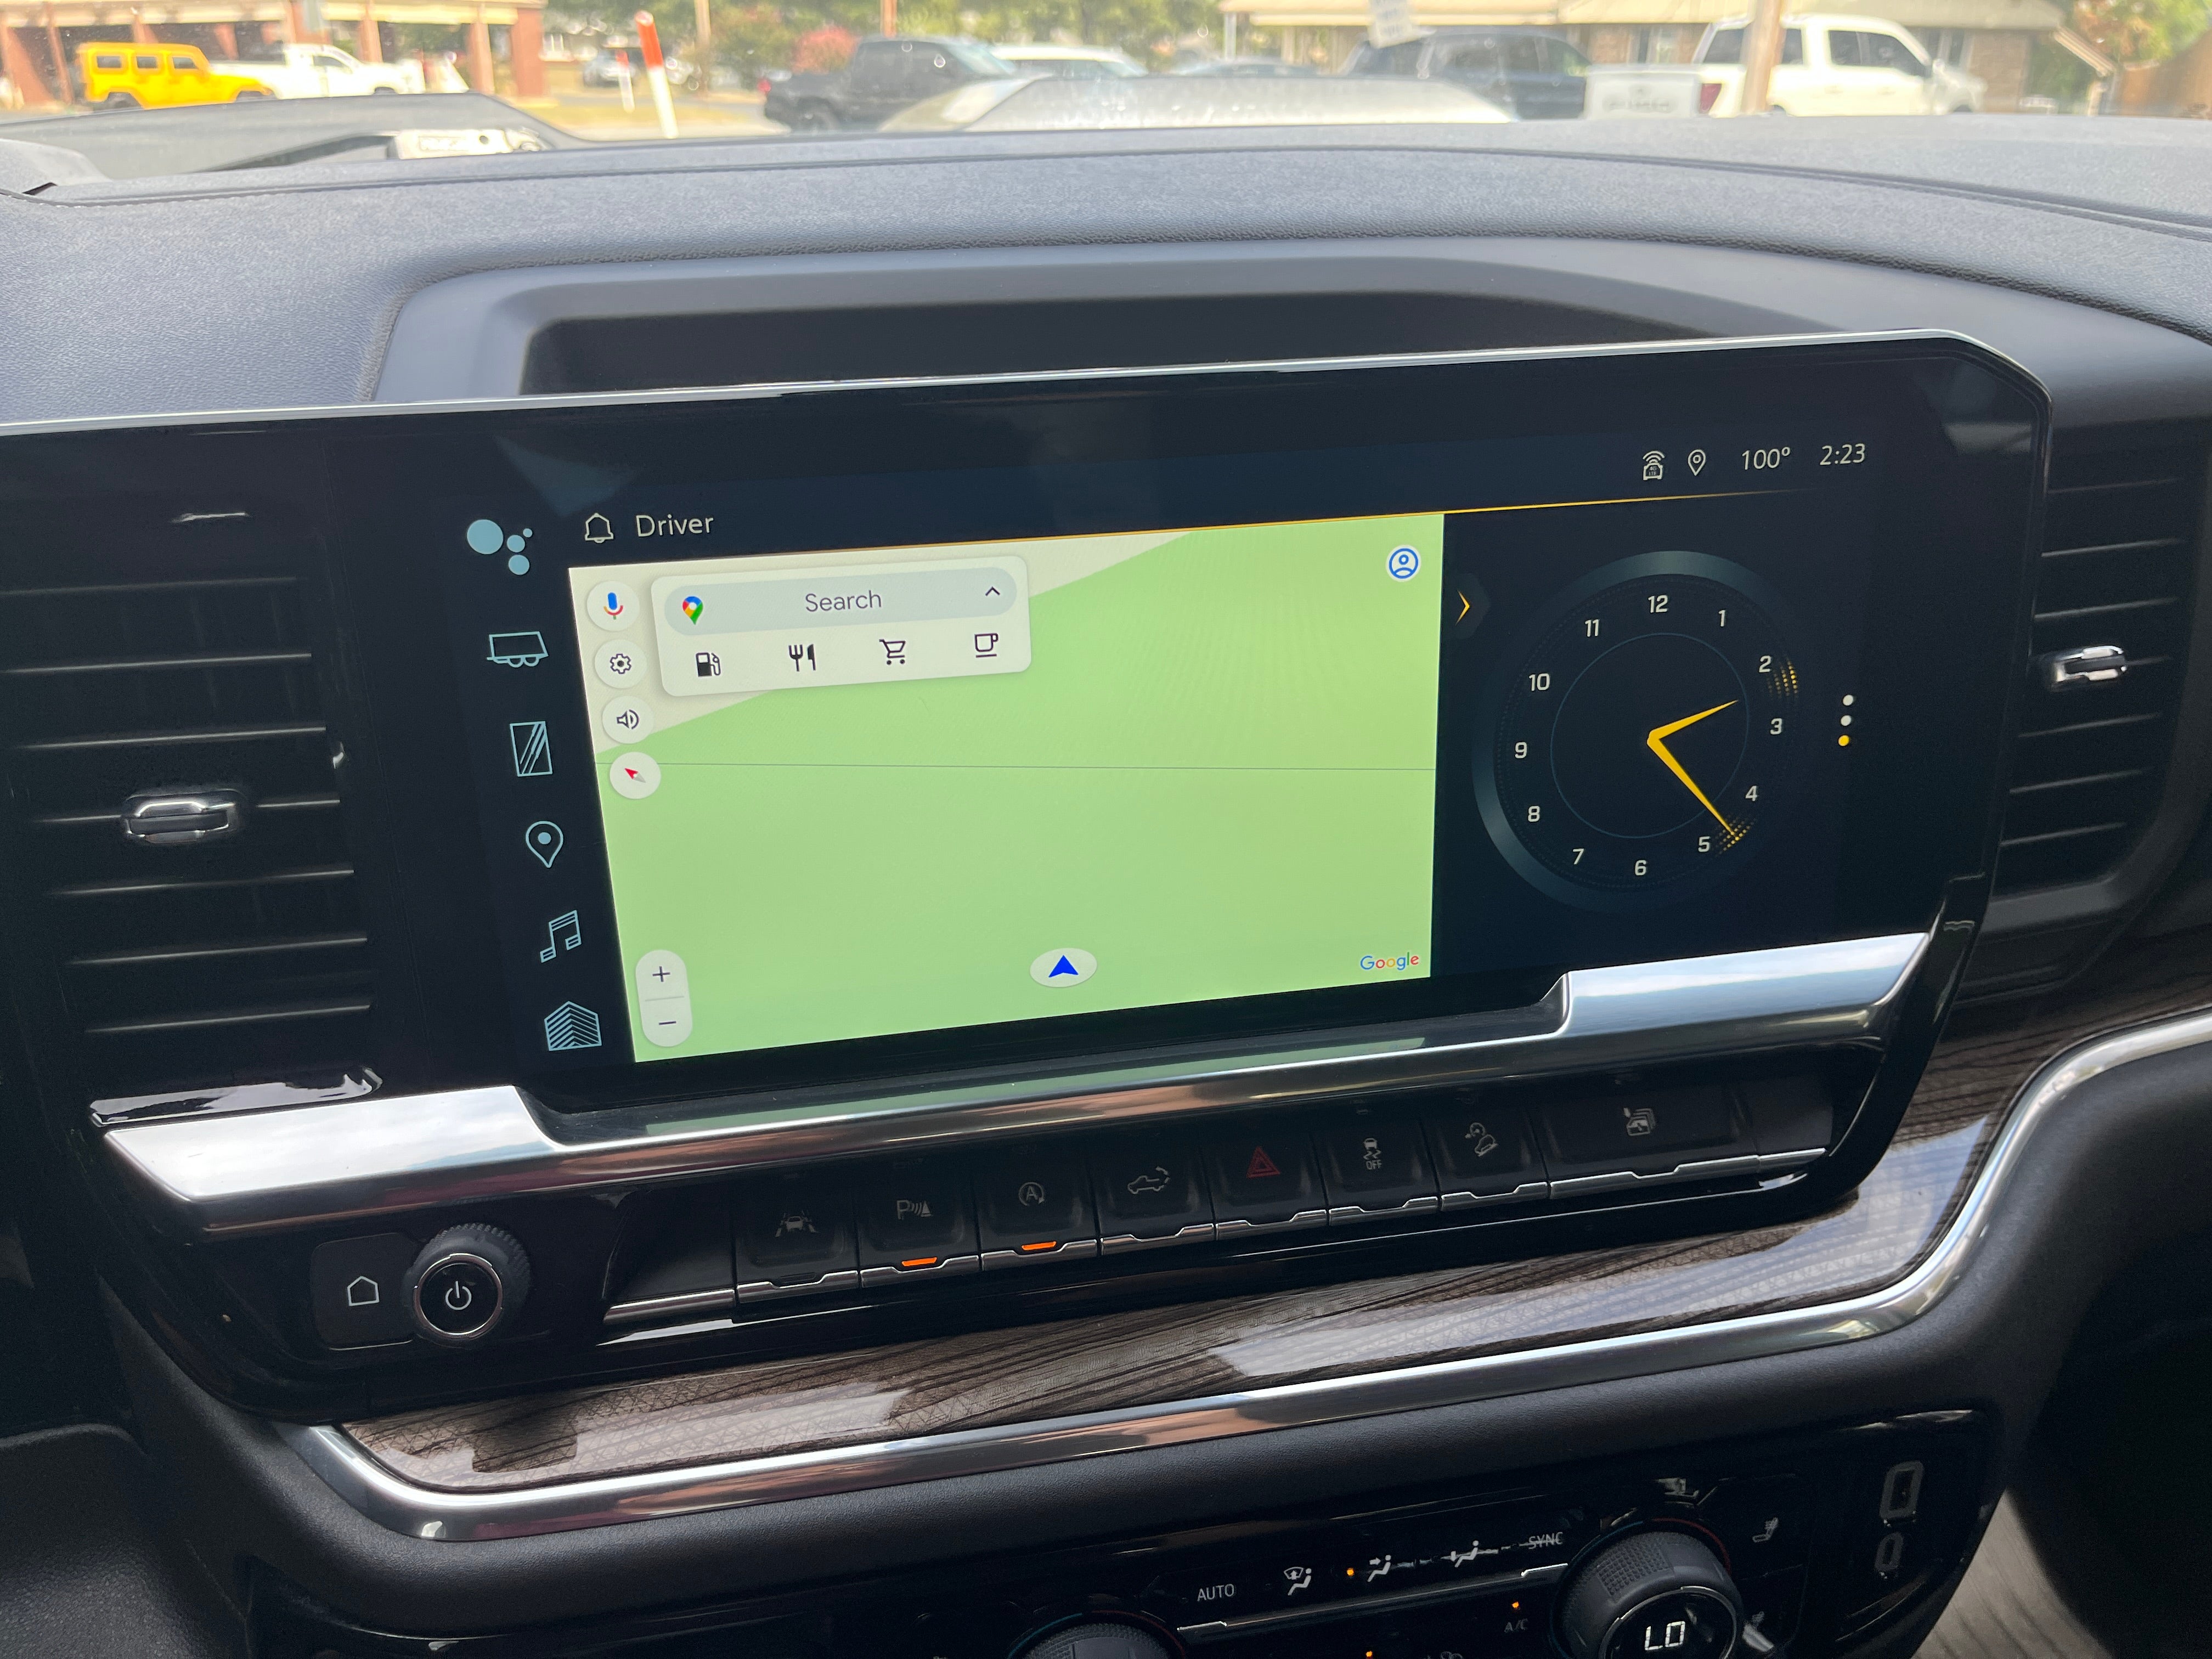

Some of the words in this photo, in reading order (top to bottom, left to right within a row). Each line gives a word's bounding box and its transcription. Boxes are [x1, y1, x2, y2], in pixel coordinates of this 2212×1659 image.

[1820, 444, 1865, 465] 2:23
[636, 514, 713, 537] Driver
[806, 590, 881, 611] Search
[1649, 595, 1668, 613] 12
[1719, 610, 1725, 627] 1
[1585, 619, 1599, 636] 11
[1759, 656, 1771, 672] 2
[1529, 674, 1550, 691] 10
[1770, 718, 1782, 734] 3
[1515, 742, 1527, 758] 9
[1746, 786, 1757, 801] 4
[1528, 806, 1539, 822] 8
[1699, 837, 1709, 852] 5
[1573, 849, 1584, 864] 7
[1635, 860, 1646, 875] 6
[1360, 952, 1419, 970] Google
[1366, 1160, 1381, 1170] OFF
[1528, 1532, 1563, 1550] SYNC
[1198, 1584, 1235, 1601] AUTO
[1504, 1619, 1527, 1633] A/C
